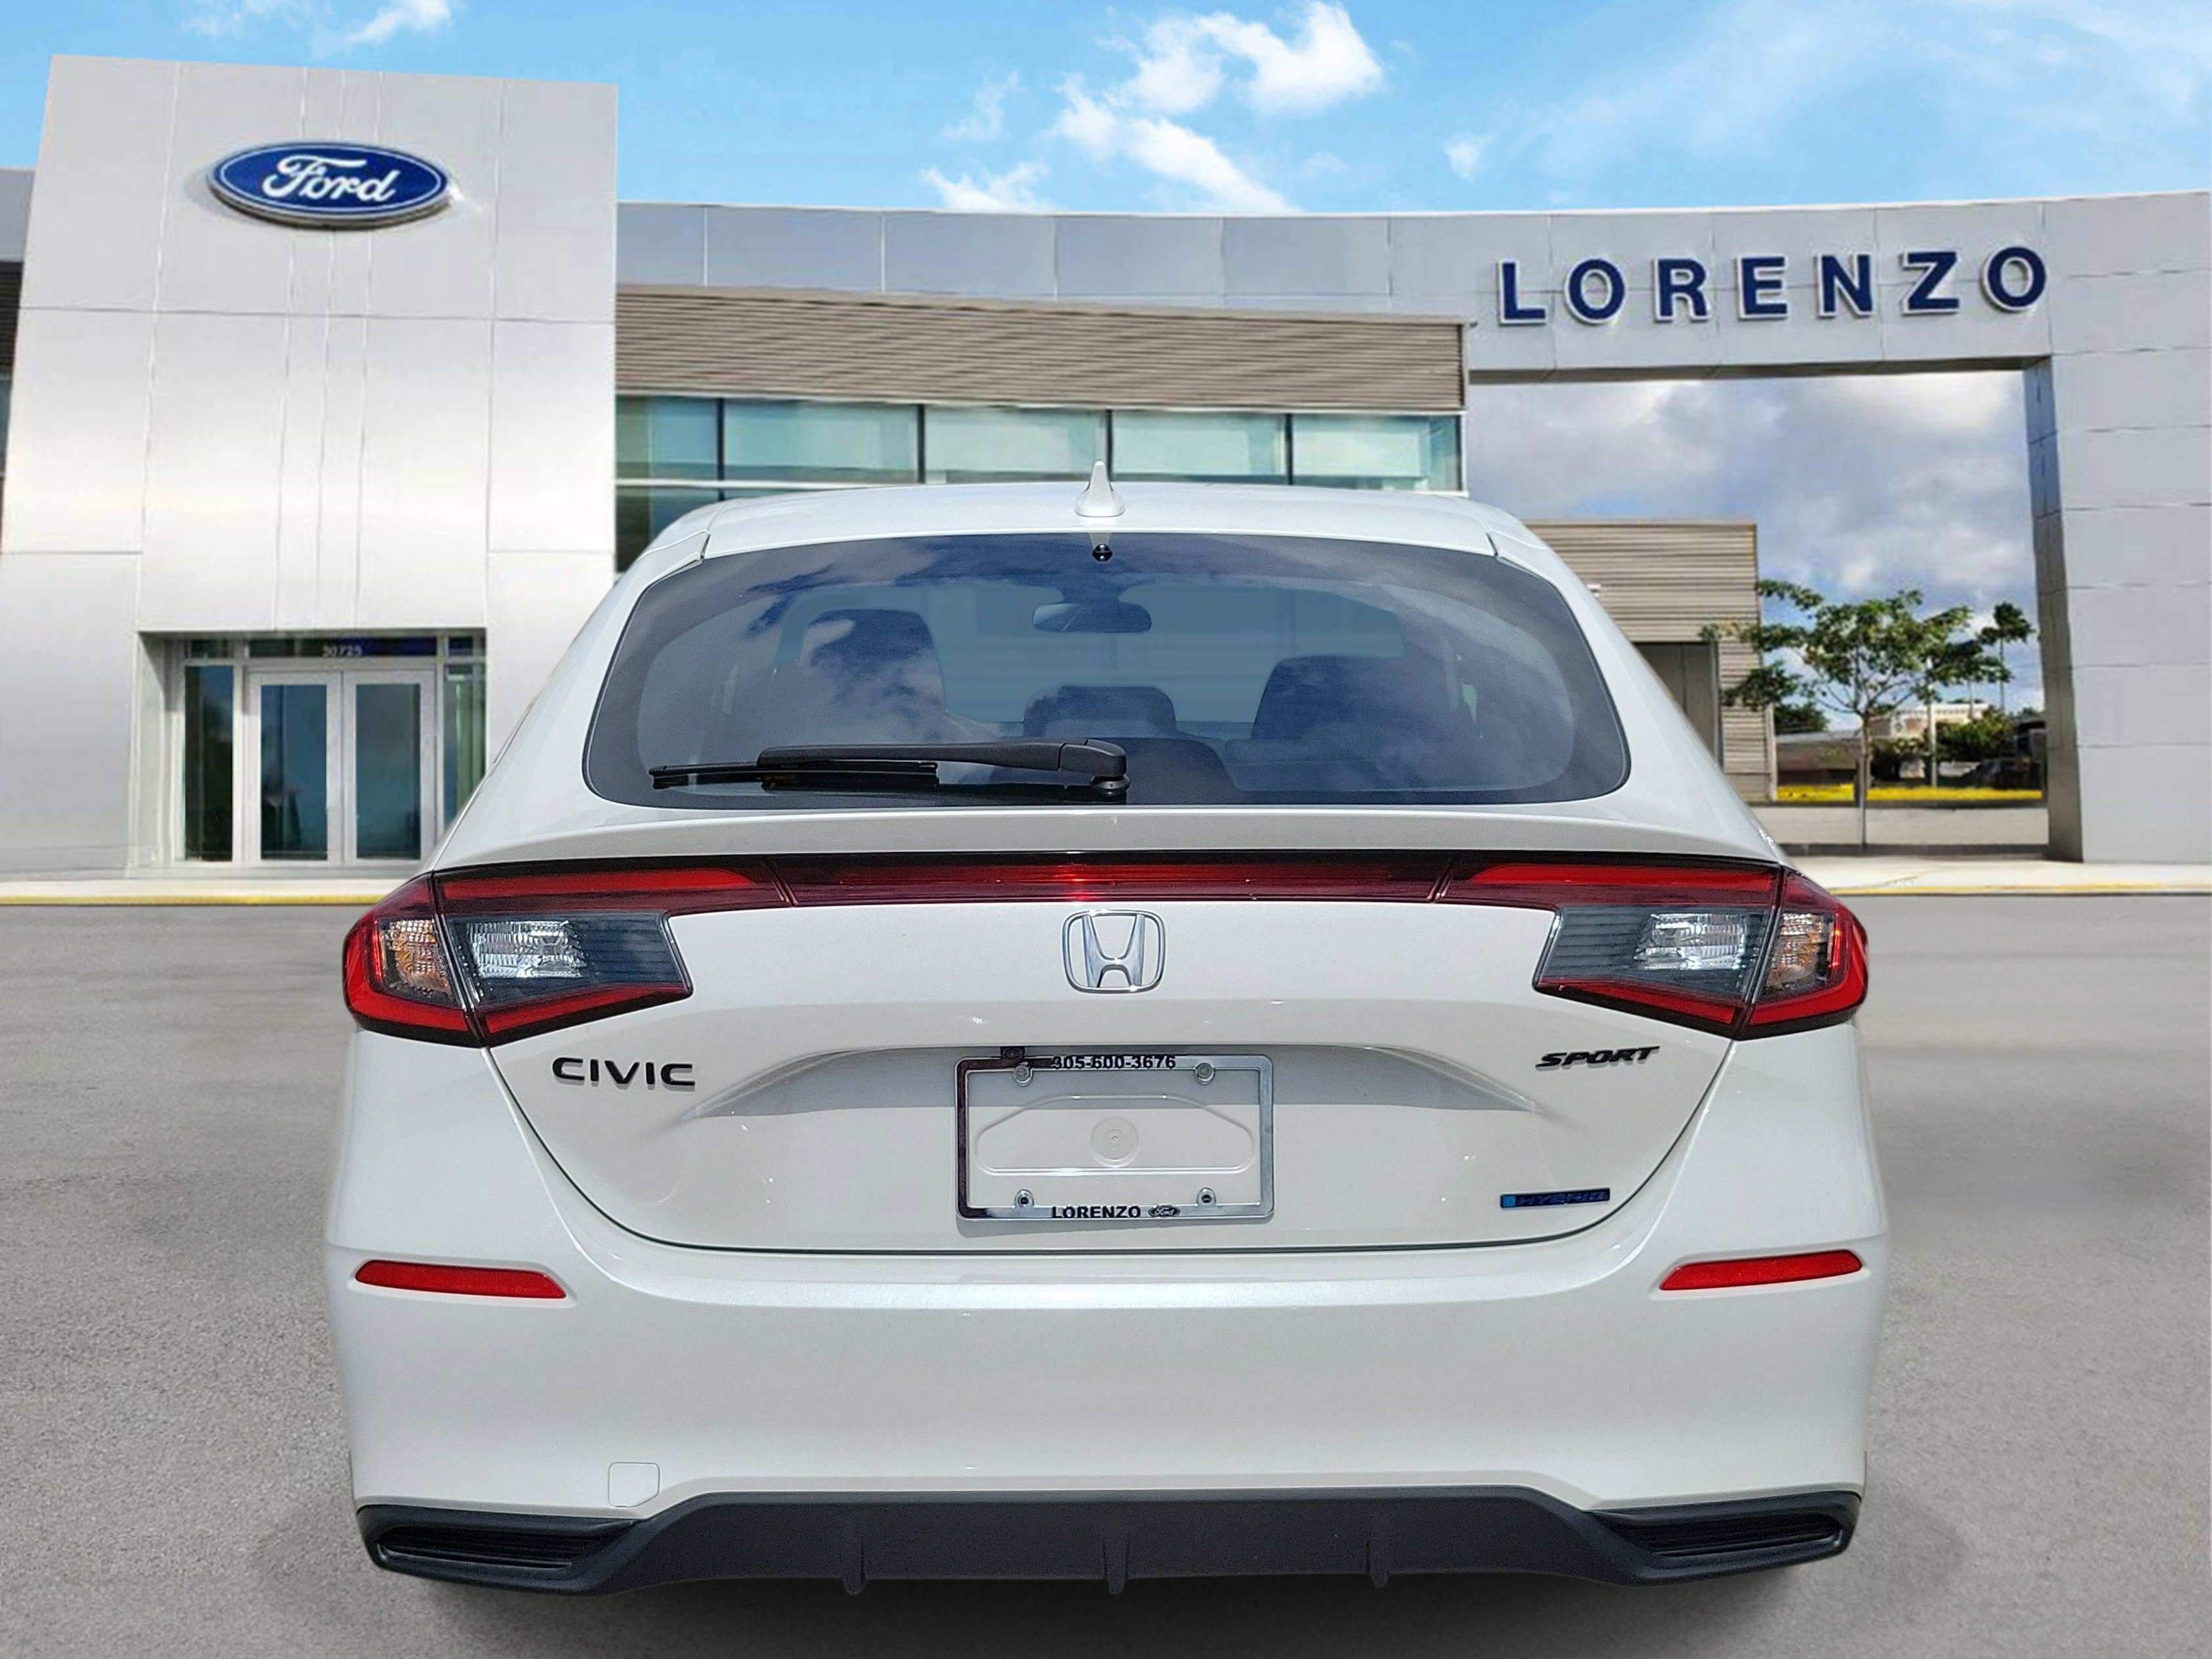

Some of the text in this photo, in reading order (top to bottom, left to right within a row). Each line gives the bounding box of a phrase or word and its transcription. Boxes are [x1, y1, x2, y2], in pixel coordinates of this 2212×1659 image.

[262, 154, 400, 201] Ford
[1499, 246, 2047, 324] LORENZO
[1052, 1055, 1176, 1069] 305-600-3676
[1535, 1045, 1661, 1068] SPORT
[552, 1056, 696, 1088] CIVIC
[1052, 1205, 1141, 1219] LORENZO
